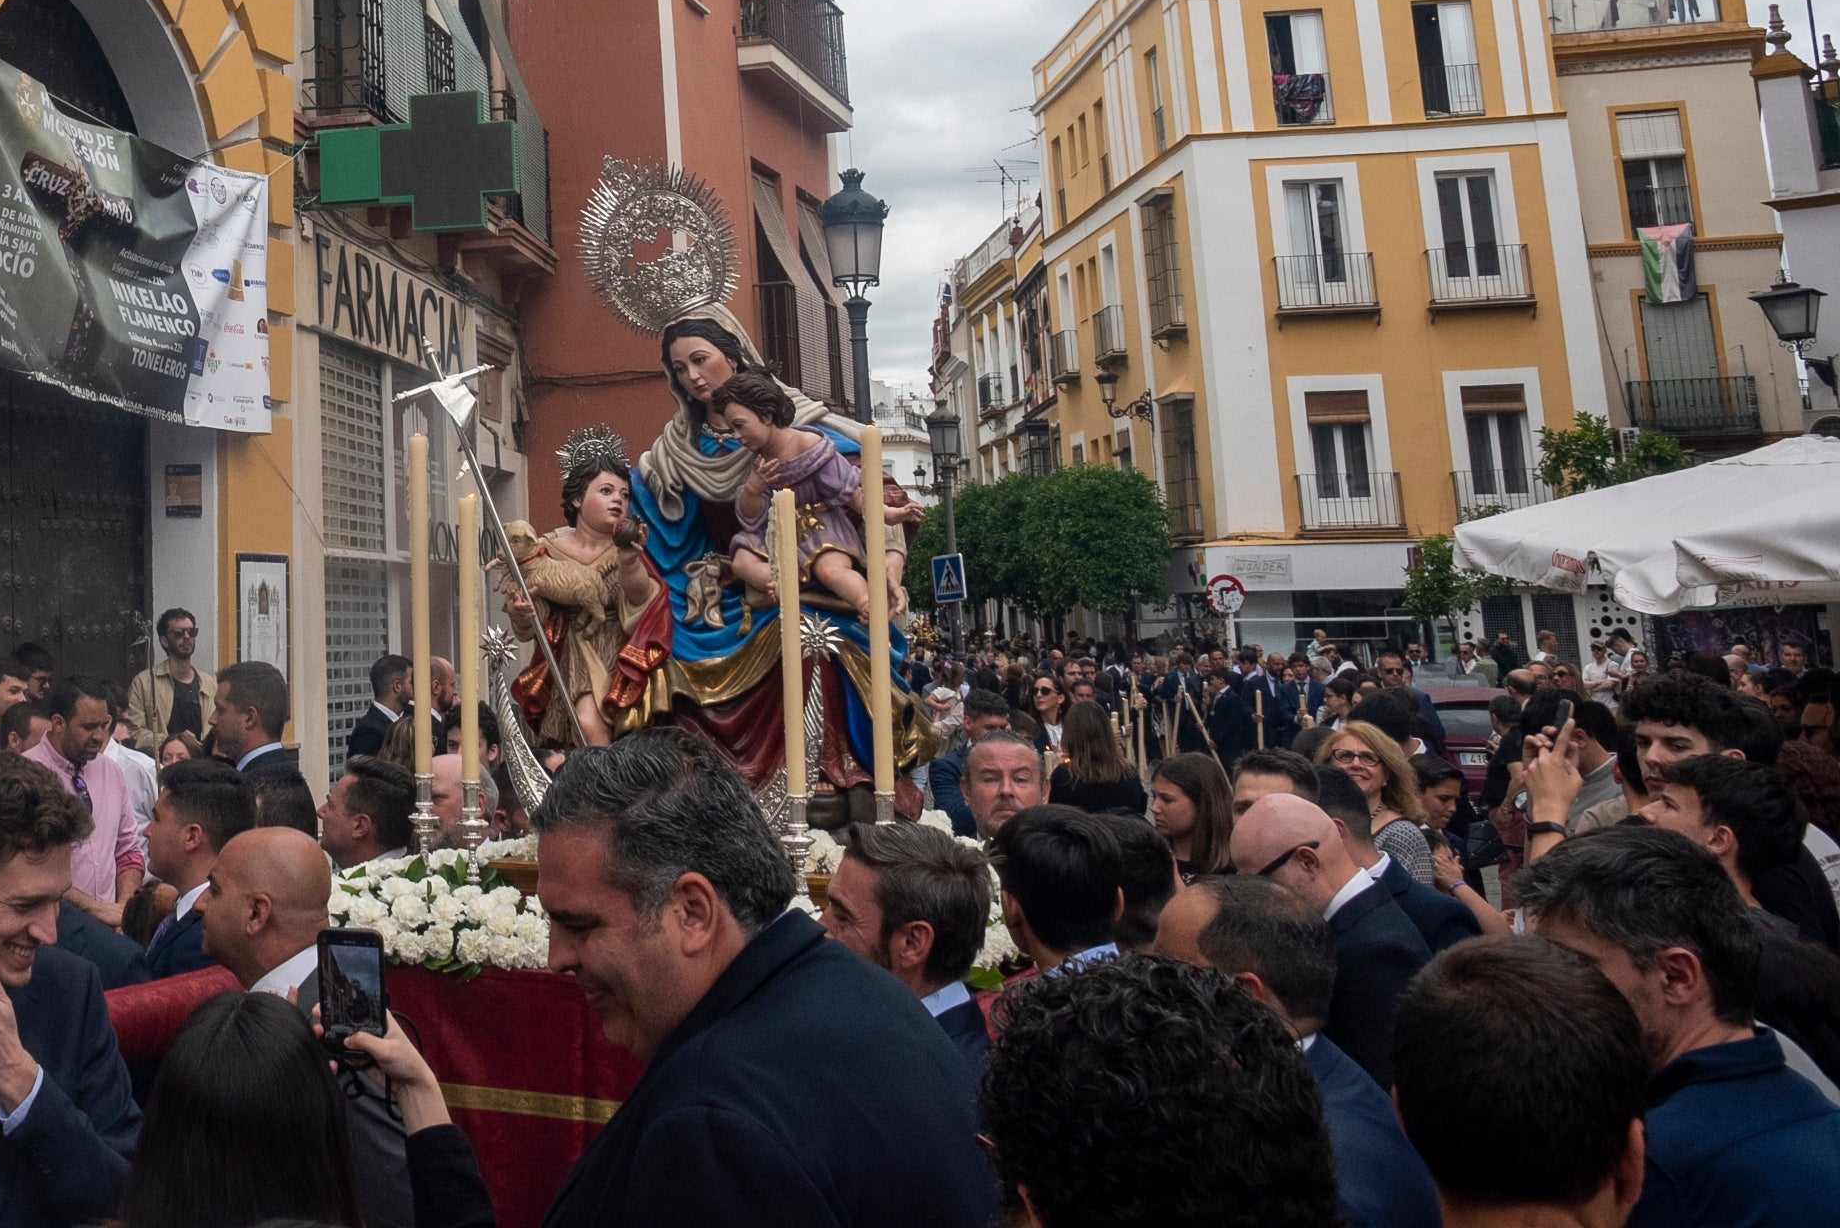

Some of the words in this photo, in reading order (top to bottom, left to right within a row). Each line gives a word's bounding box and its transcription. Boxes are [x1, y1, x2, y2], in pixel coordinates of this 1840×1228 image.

[97, 133, 116, 151] DE
[2, 184, 12, 198] 3
[27, 166, 71, 196] CRUZ
[2, 207, 17, 220] DE
[18, 212, 41, 229] MAYO
[102, 193, 133, 224] MAYO
[109, 277, 188, 315] NIKELAO
[316, 233, 463, 373] FARMACIA
[118, 305, 195, 337] FLAMENCO
[131, 347, 187, 380] TONELEROS
[1236, 561, 1284, 572] WONDER
